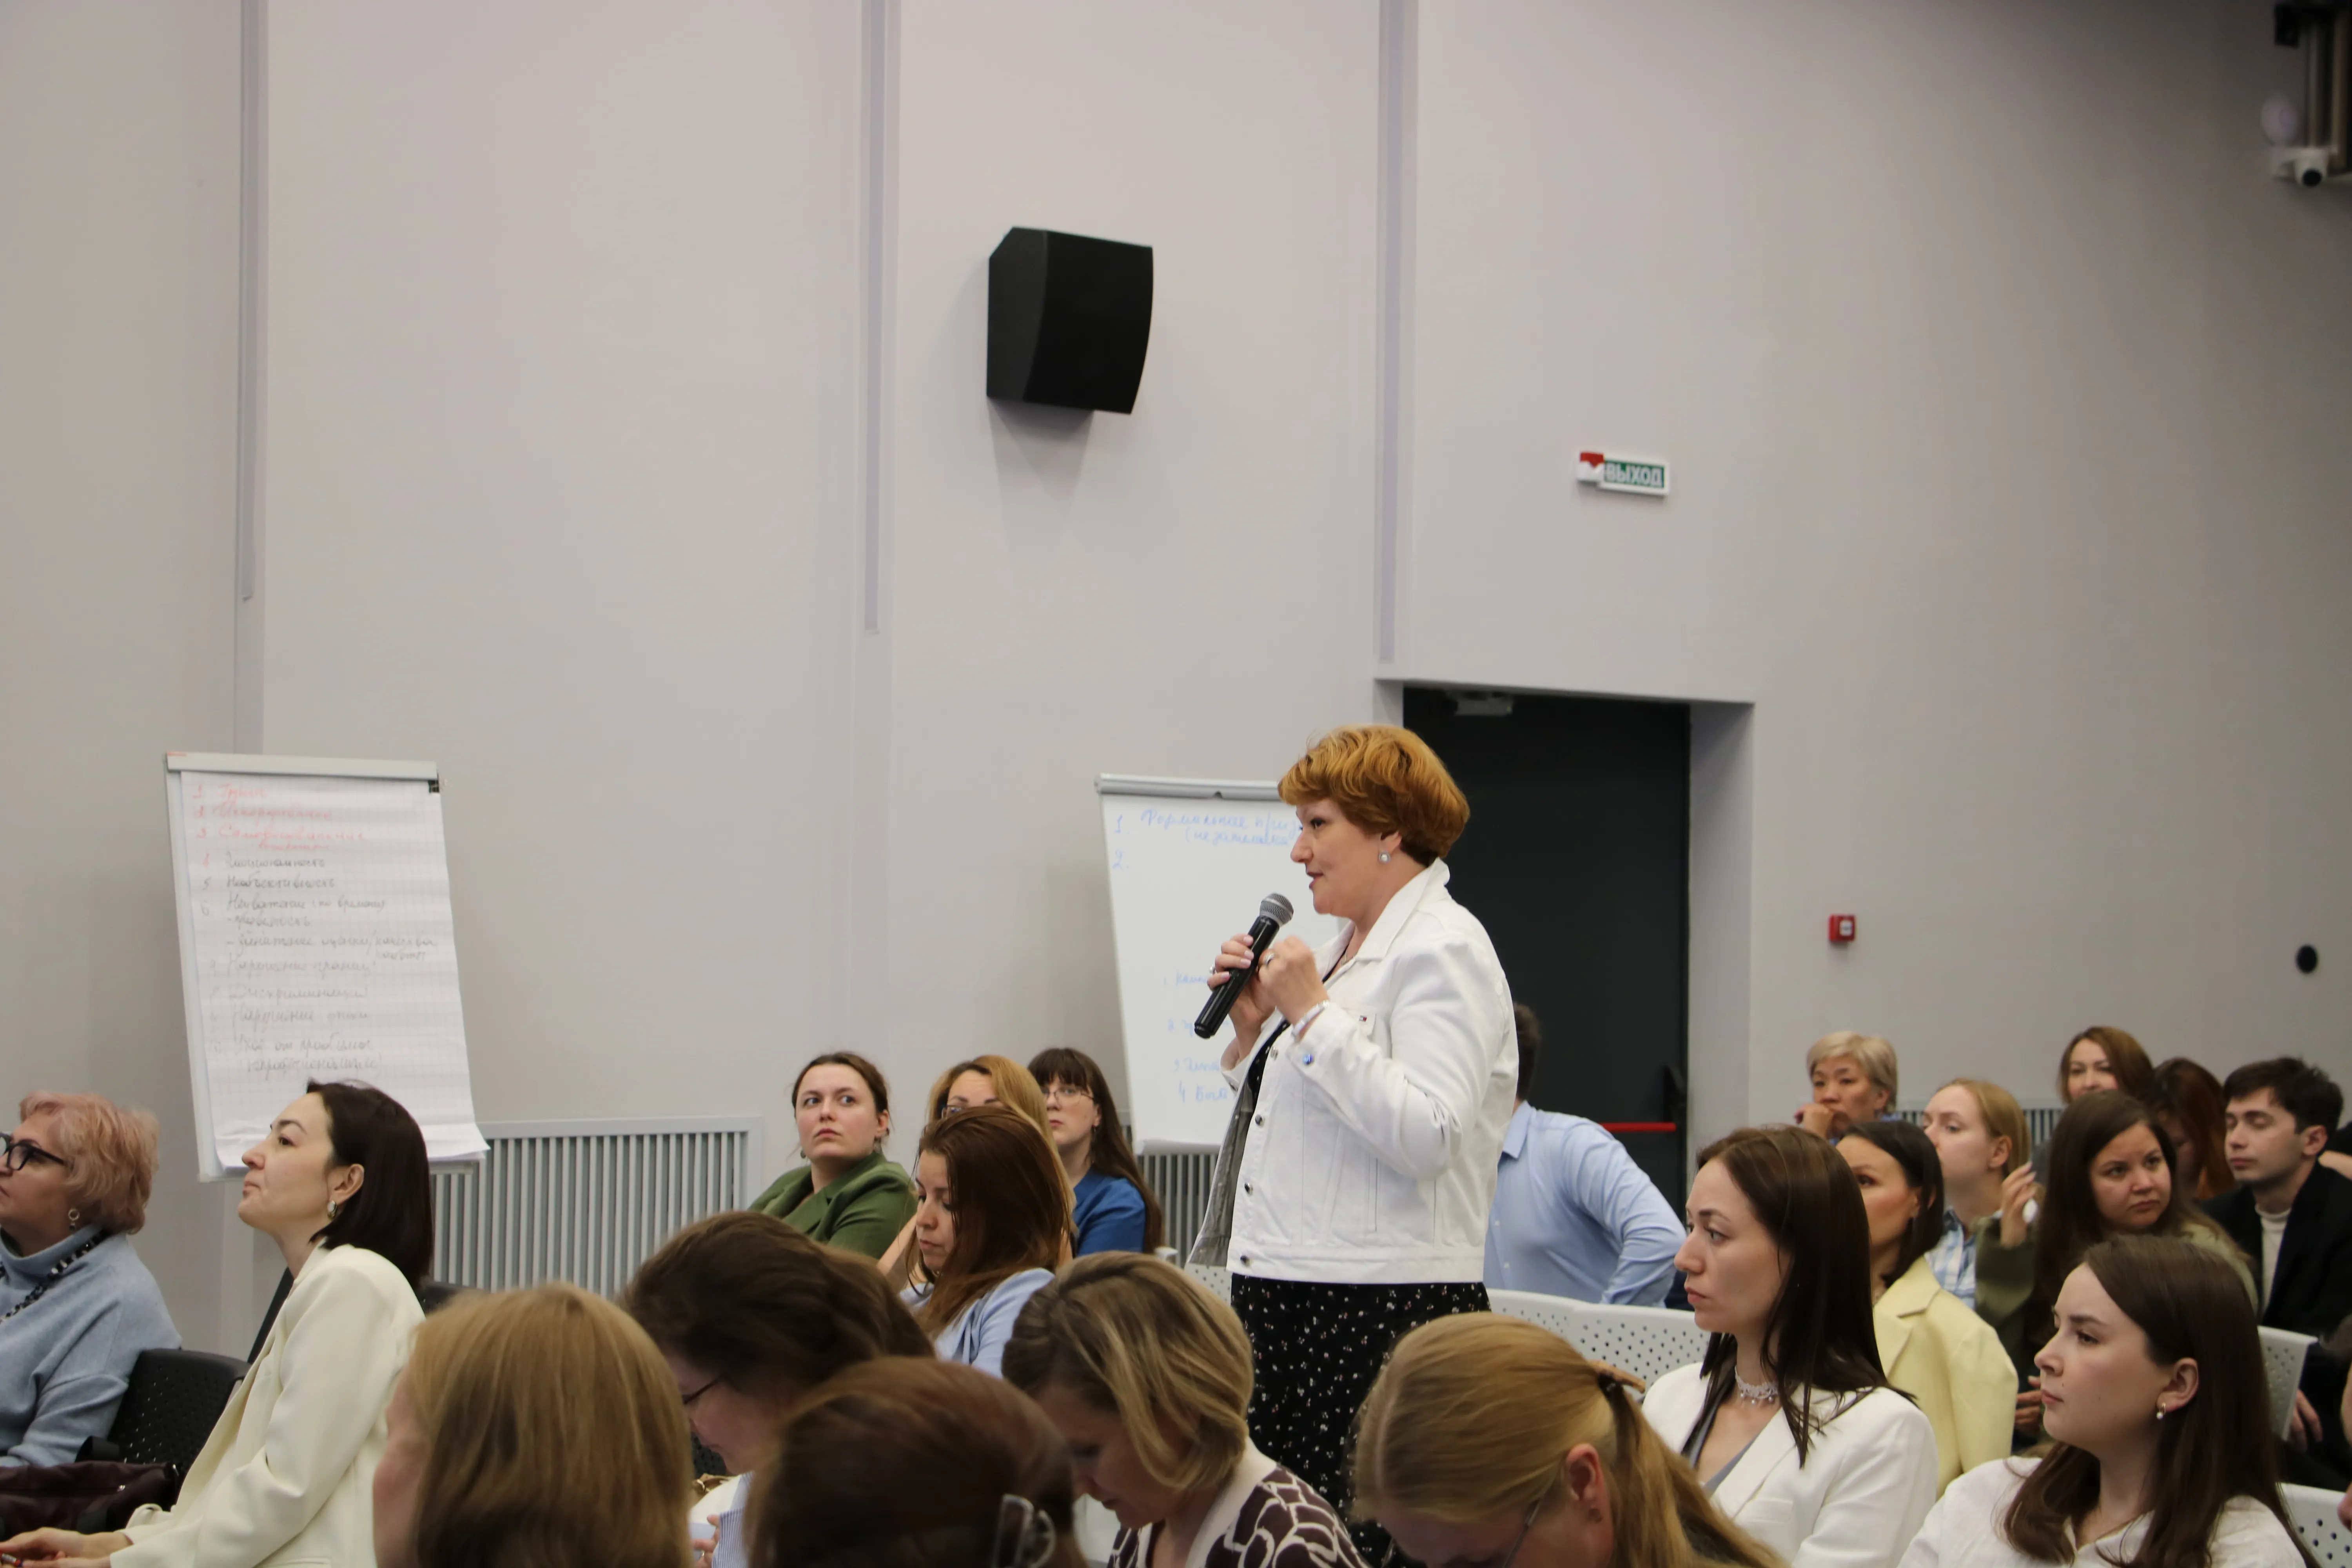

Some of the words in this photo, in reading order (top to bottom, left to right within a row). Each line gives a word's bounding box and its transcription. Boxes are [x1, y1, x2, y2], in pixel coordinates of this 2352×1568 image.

[1606, 462, 1662, 486] ВЫХОД
[202, 876, 212, 890] 5
[227, 871, 336, 889] Необъективность
[201, 900, 210, 916] 6
[227, 894, 306, 910] Неуважение
[227, 952, 307, 979] Нарушение
[229, 984, 368, 1005] Дискриминация
[232, 1002, 314, 1033] Нарушение
[275, 1041, 293, 1051] от
